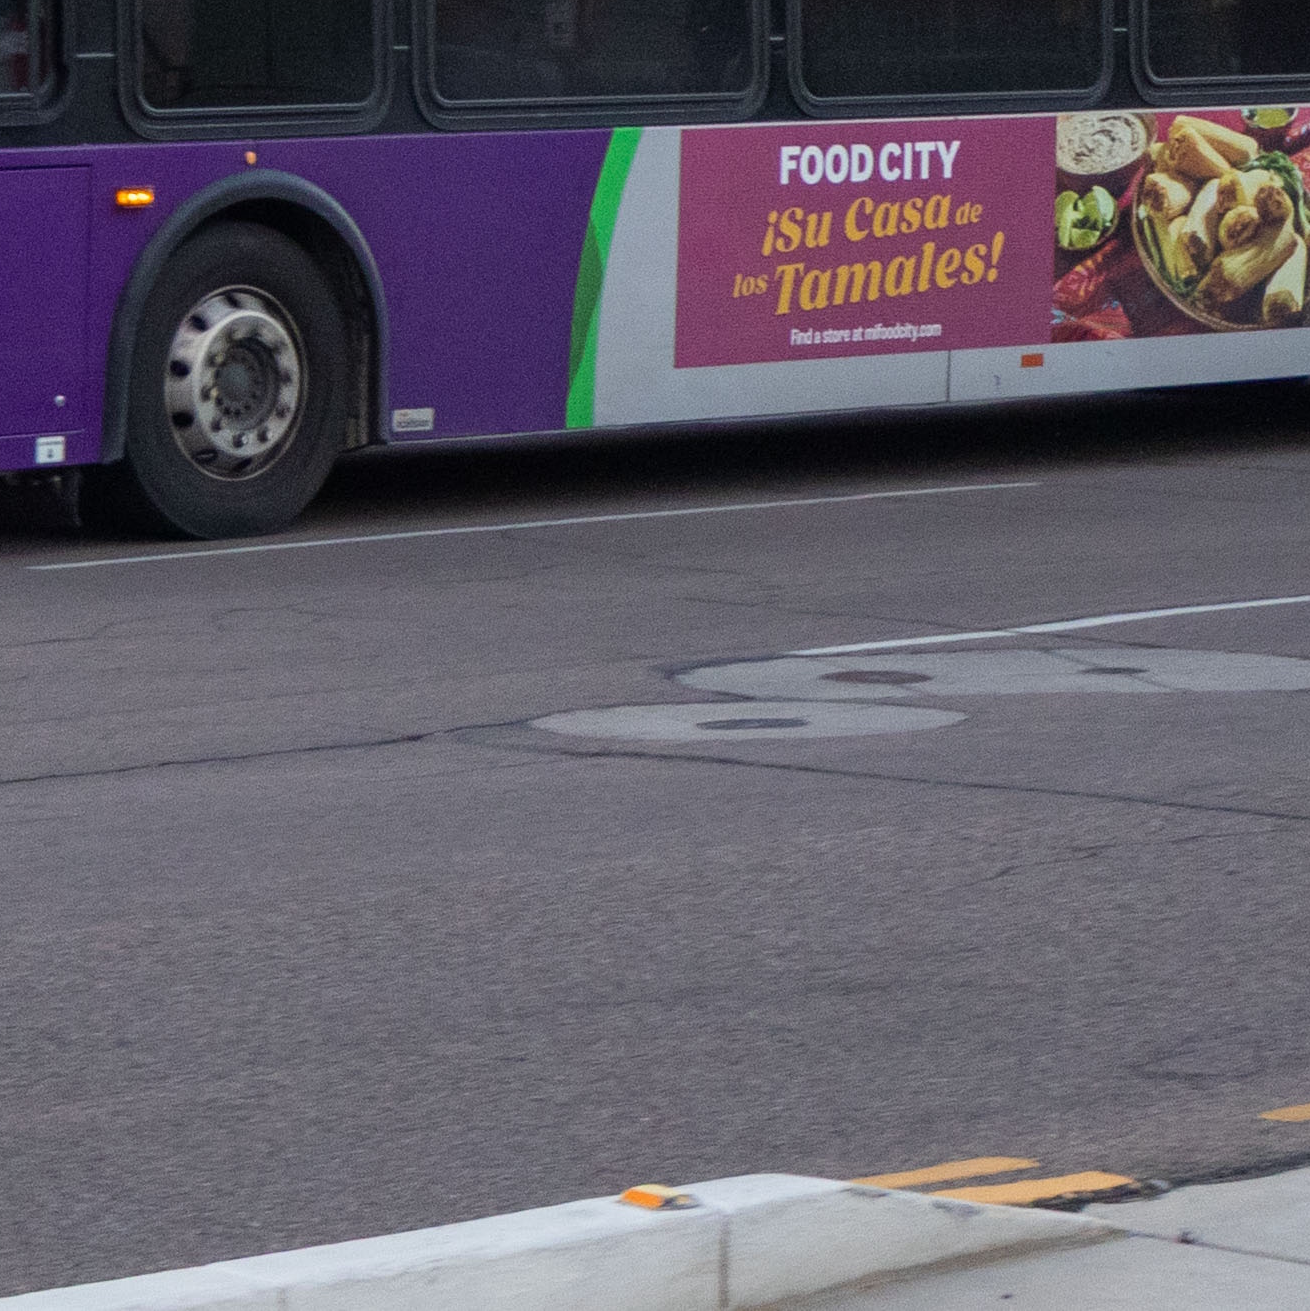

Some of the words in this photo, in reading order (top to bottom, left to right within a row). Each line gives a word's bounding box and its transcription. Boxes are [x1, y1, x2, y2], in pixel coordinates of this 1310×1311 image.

[780, 144, 875, 185] FOOD
[878, 140, 961, 181] CITY
[761, 207, 833, 256] ¡Su
[844, 194, 952, 242] Casa
[955, 201, 983, 226] de
[732, 273, 769, 298] los
[775, 231, 1005, 315] Tamales!
[790, 328, 813, 346] Find
[813, 331, 821, 344] a
[822, 329, 851, 344] store
[852, 326, 863, 341] at
